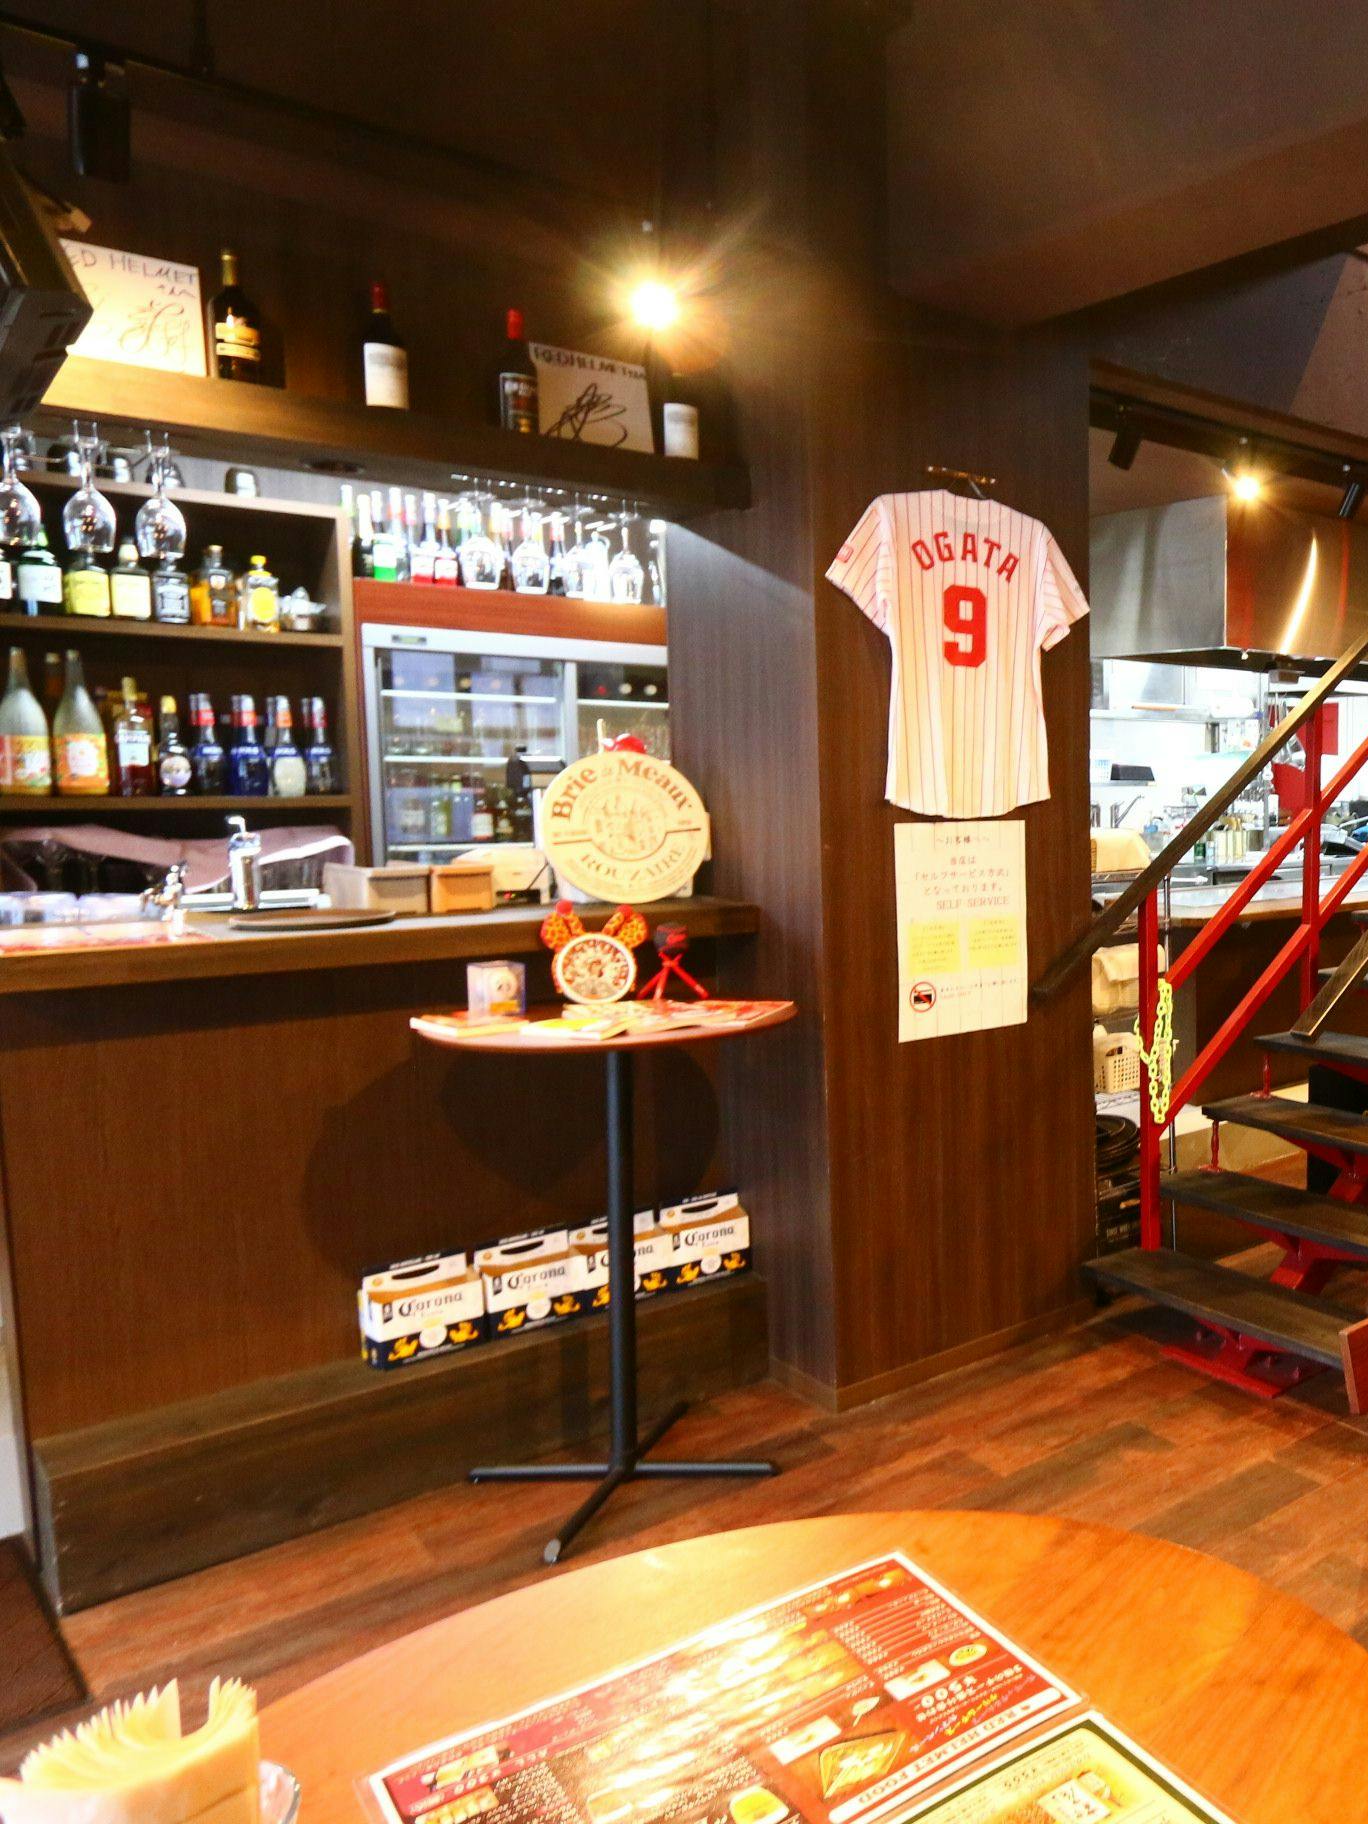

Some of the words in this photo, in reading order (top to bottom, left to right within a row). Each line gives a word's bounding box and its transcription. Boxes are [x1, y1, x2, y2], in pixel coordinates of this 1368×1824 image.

[911, 531, 1020, 583] OGATA
[943, 584, 988, 668] 9
[551, 766, 598, 820] Brie
[937, 898, 961, 910] SELF
[967, 894, 1009, 908] SERVICE
[683, 1226, 734, 1247] Corona
[507, 1265, 566, 1290] Corona
[398, 1292, 463, 1318] Corona
[982, 1709, 1018, 1733] RED
[913, 1729, 981, 1773] HELMET
[856, 1771, 908, 1806] FOOD
